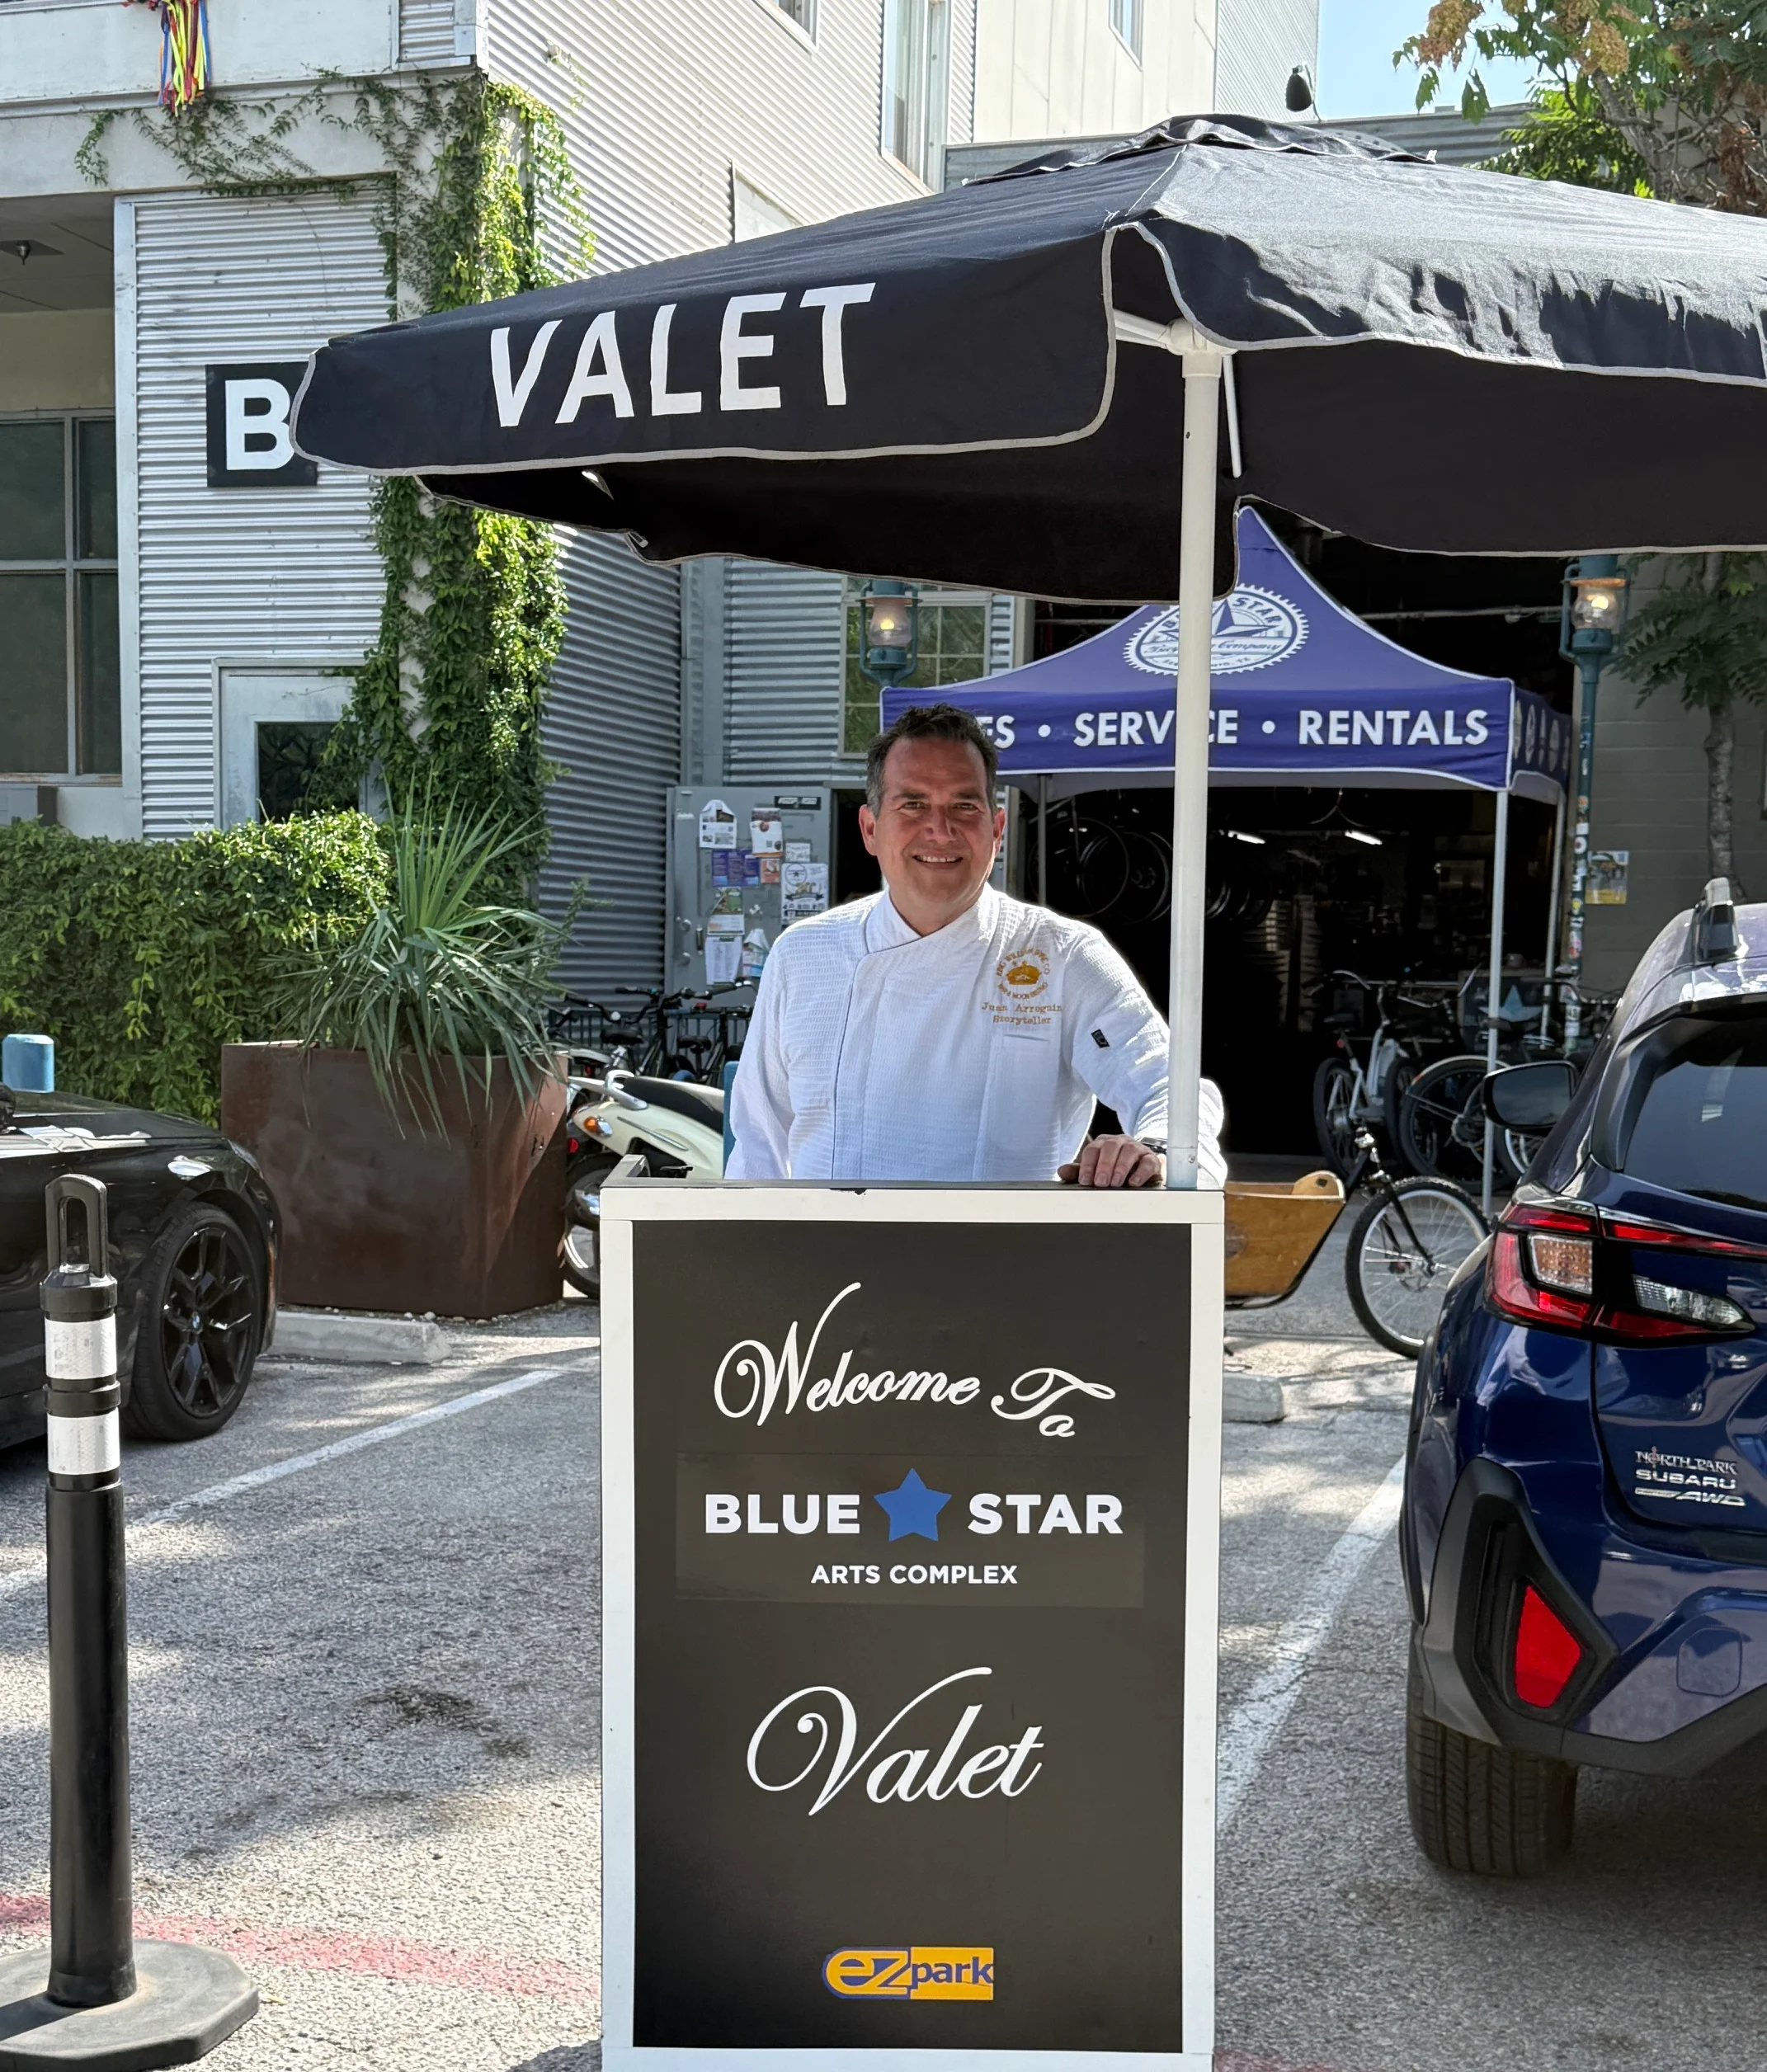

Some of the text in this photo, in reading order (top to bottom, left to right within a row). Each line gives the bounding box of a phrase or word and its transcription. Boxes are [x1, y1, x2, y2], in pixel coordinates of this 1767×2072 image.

[490, 282, 876, 427] VALET
[225, 379, 293, 470] B
[1232, 597, 1282, 624] STAR
[1074, 710, 1237, 747] SERVE
[1298, 710, 1488, 746] RENTALS
[992, 1015, 1051, 1025] Storyteller
[714, 1282, 1116, 1438] Welcome To
[1635, 1449, 1738, 1475] NORTH PARK
[1636, 1469, 1736, 1490] SUBARU
[1675, 1490, 1746, 1506] AWD
[705, 1494, 1124, 1535] BLUE STAR
[810, 1564, 1018, 1585] ARTS COMPLEX
[747, 1666, 1044, 1816] Valet
